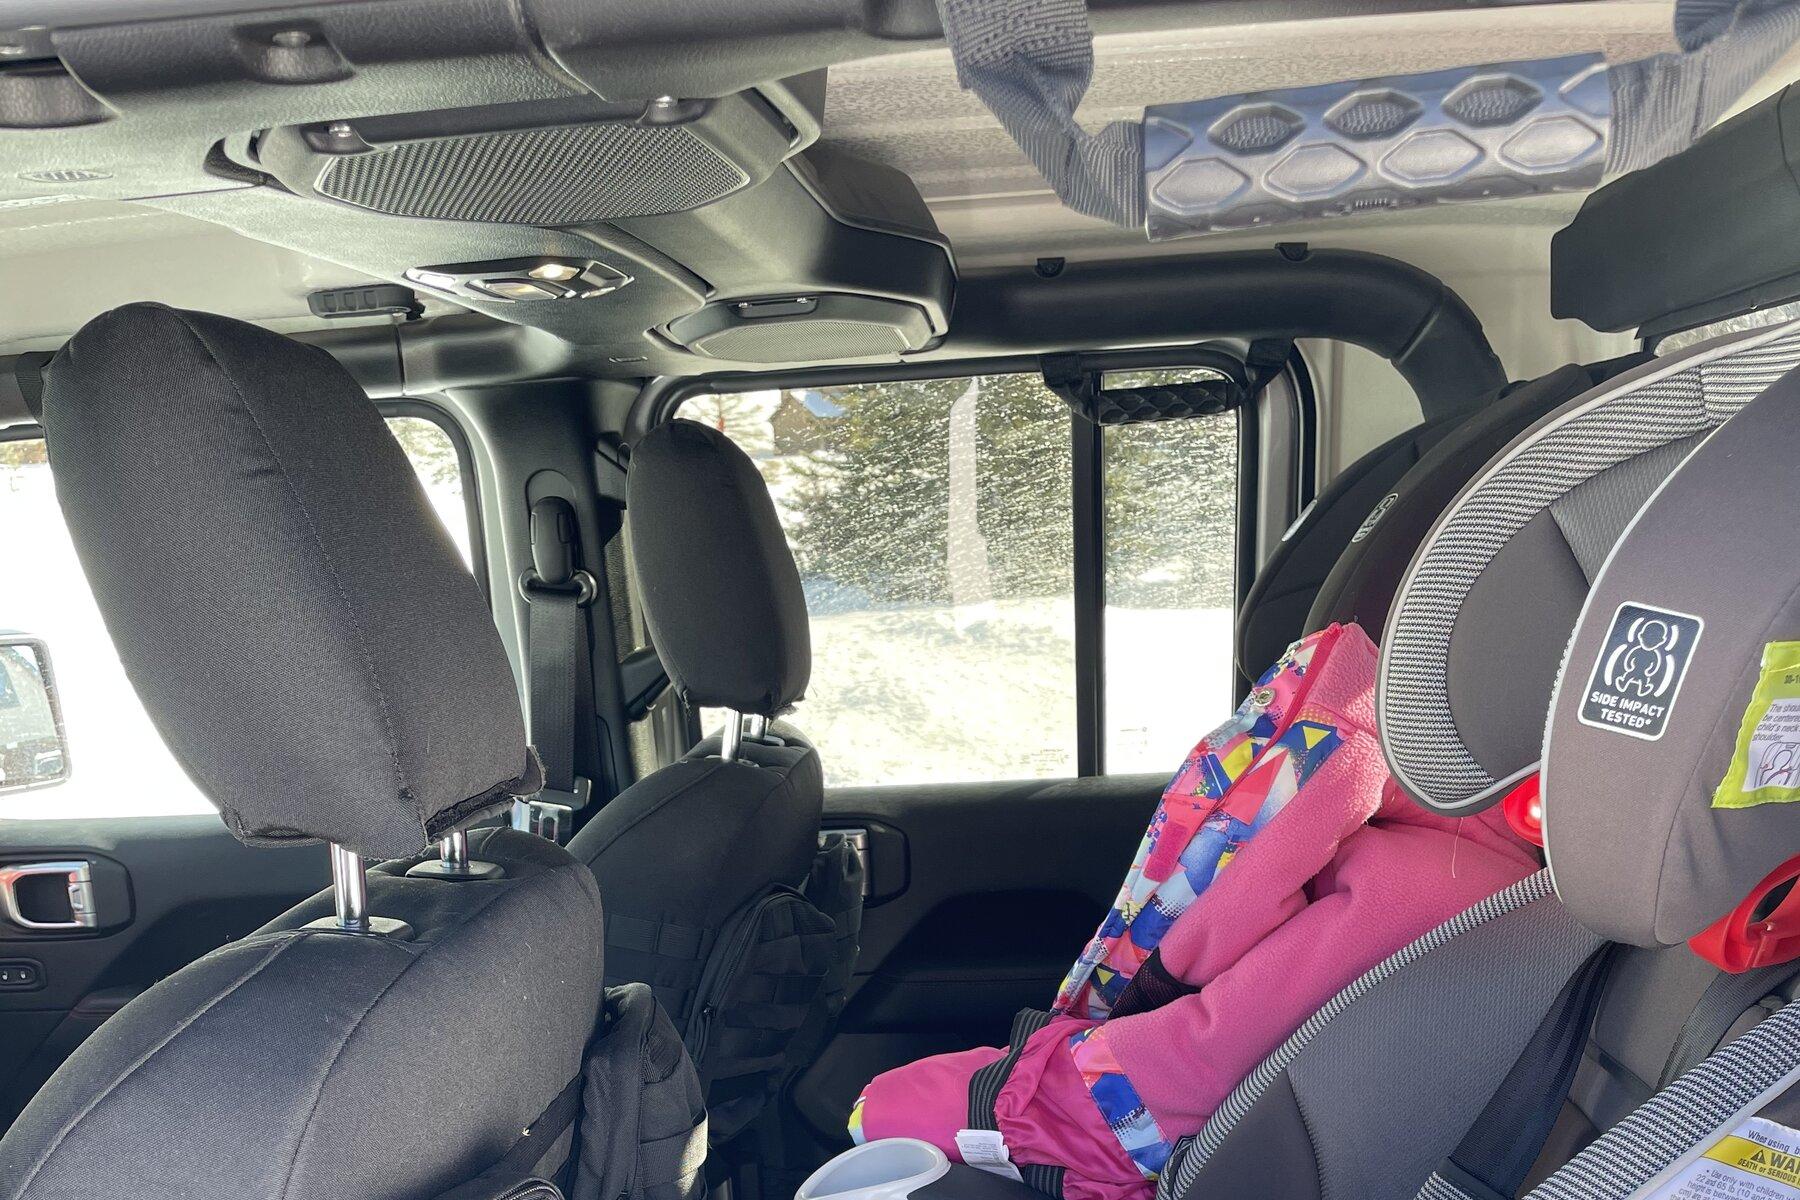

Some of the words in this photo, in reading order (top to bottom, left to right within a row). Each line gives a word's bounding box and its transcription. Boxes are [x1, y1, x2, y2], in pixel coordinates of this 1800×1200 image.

[1590, 691, 1619, 706] SIDE
[1619, 698, 1664, 717] IMPACT
[1747, 1130, 1767, 1142] When
[1767, 1138, 1790, 1153] using
[1737, 1158, 1757, 1170] DEATH
[1767, 1167, 1796, 1182] SERIOUS
[1695, 1173, 1705, 1182] 22
[1705, 1177, 1716, 1185] and
[1716, 1181, 1728, 1190] 65
[1728, 1185, 1735, 1193] lb
[1736, 1188, 1750, 1198] (10
[1710, 1170, 1721, 1178] Use
[1721, 1174, 1738, 1186] only
[1740, 1179, 1754, 1189] with
[1756, 1184, 1785, 1200] children
